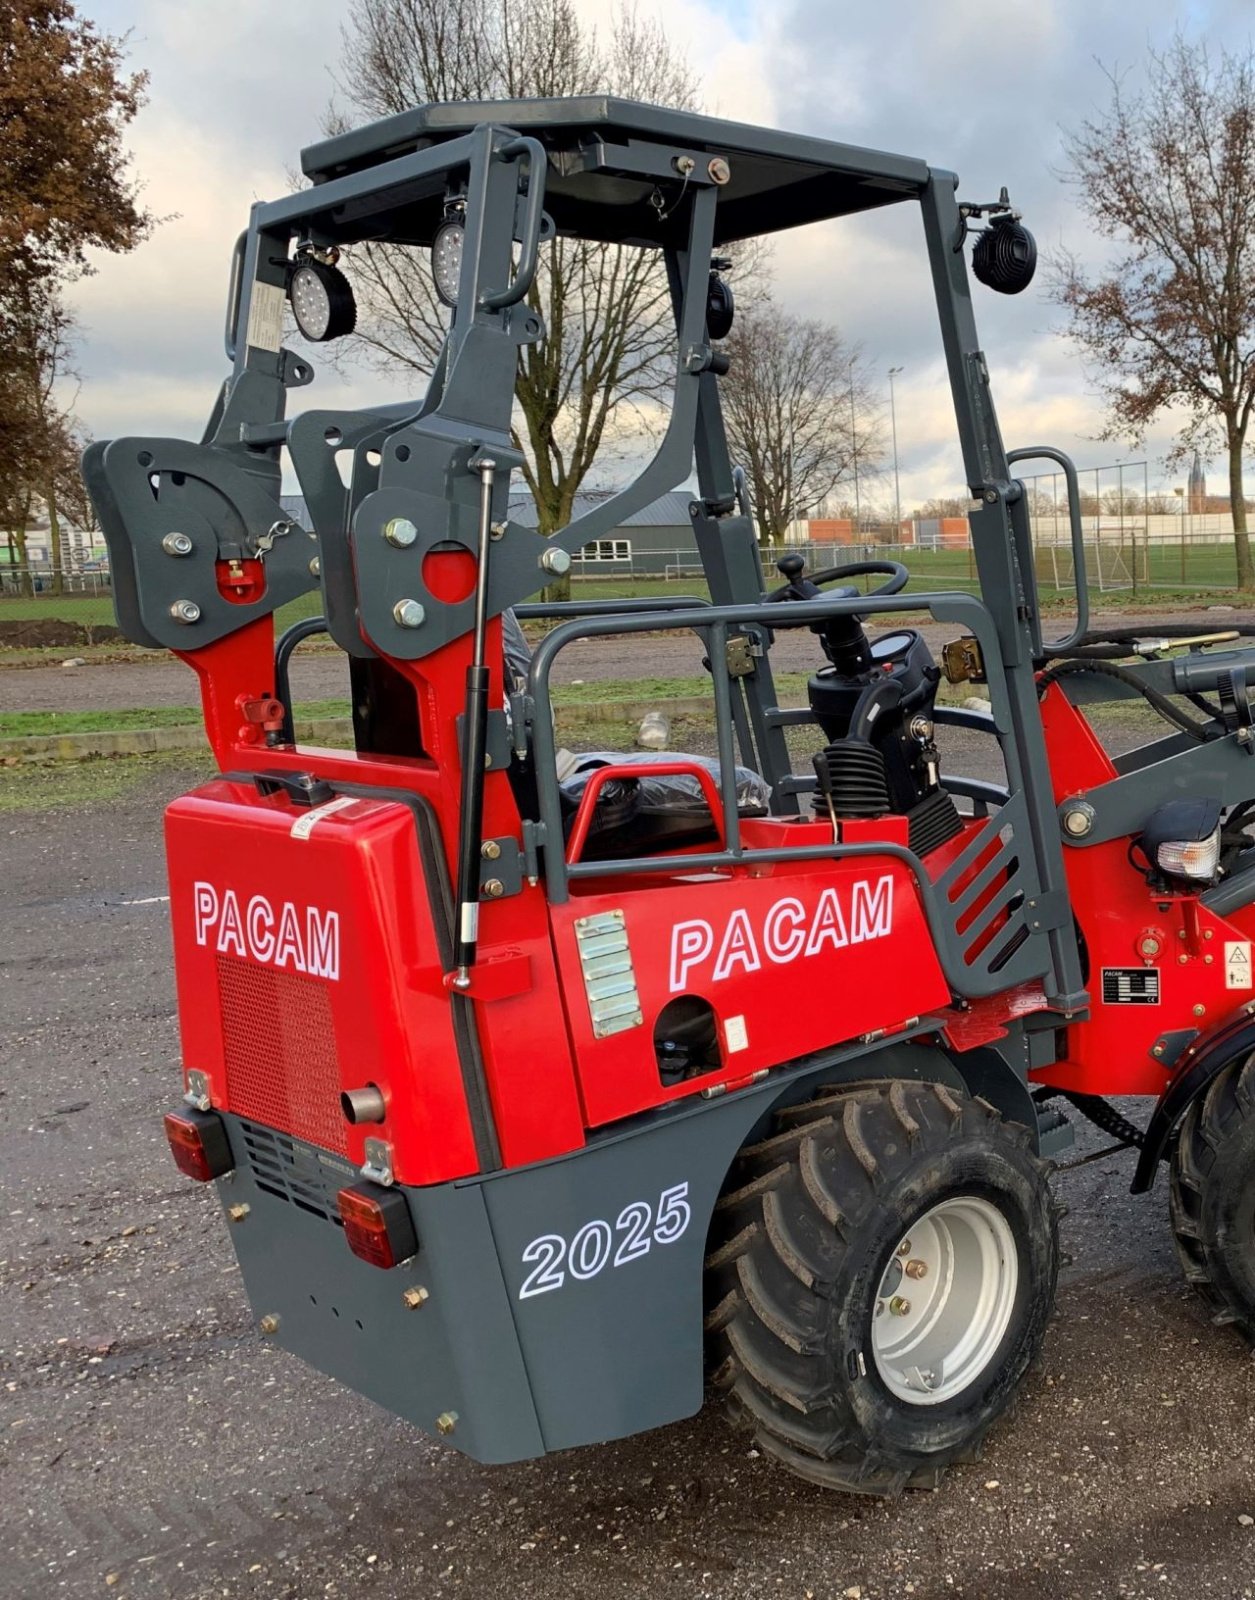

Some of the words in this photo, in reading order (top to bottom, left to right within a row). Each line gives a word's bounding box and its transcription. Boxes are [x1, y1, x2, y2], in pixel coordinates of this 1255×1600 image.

[194, 881, 340, 981] PACAM
[669, 874, 894, 993] PACAM
[519, 1181, 691, 1300] 2025
